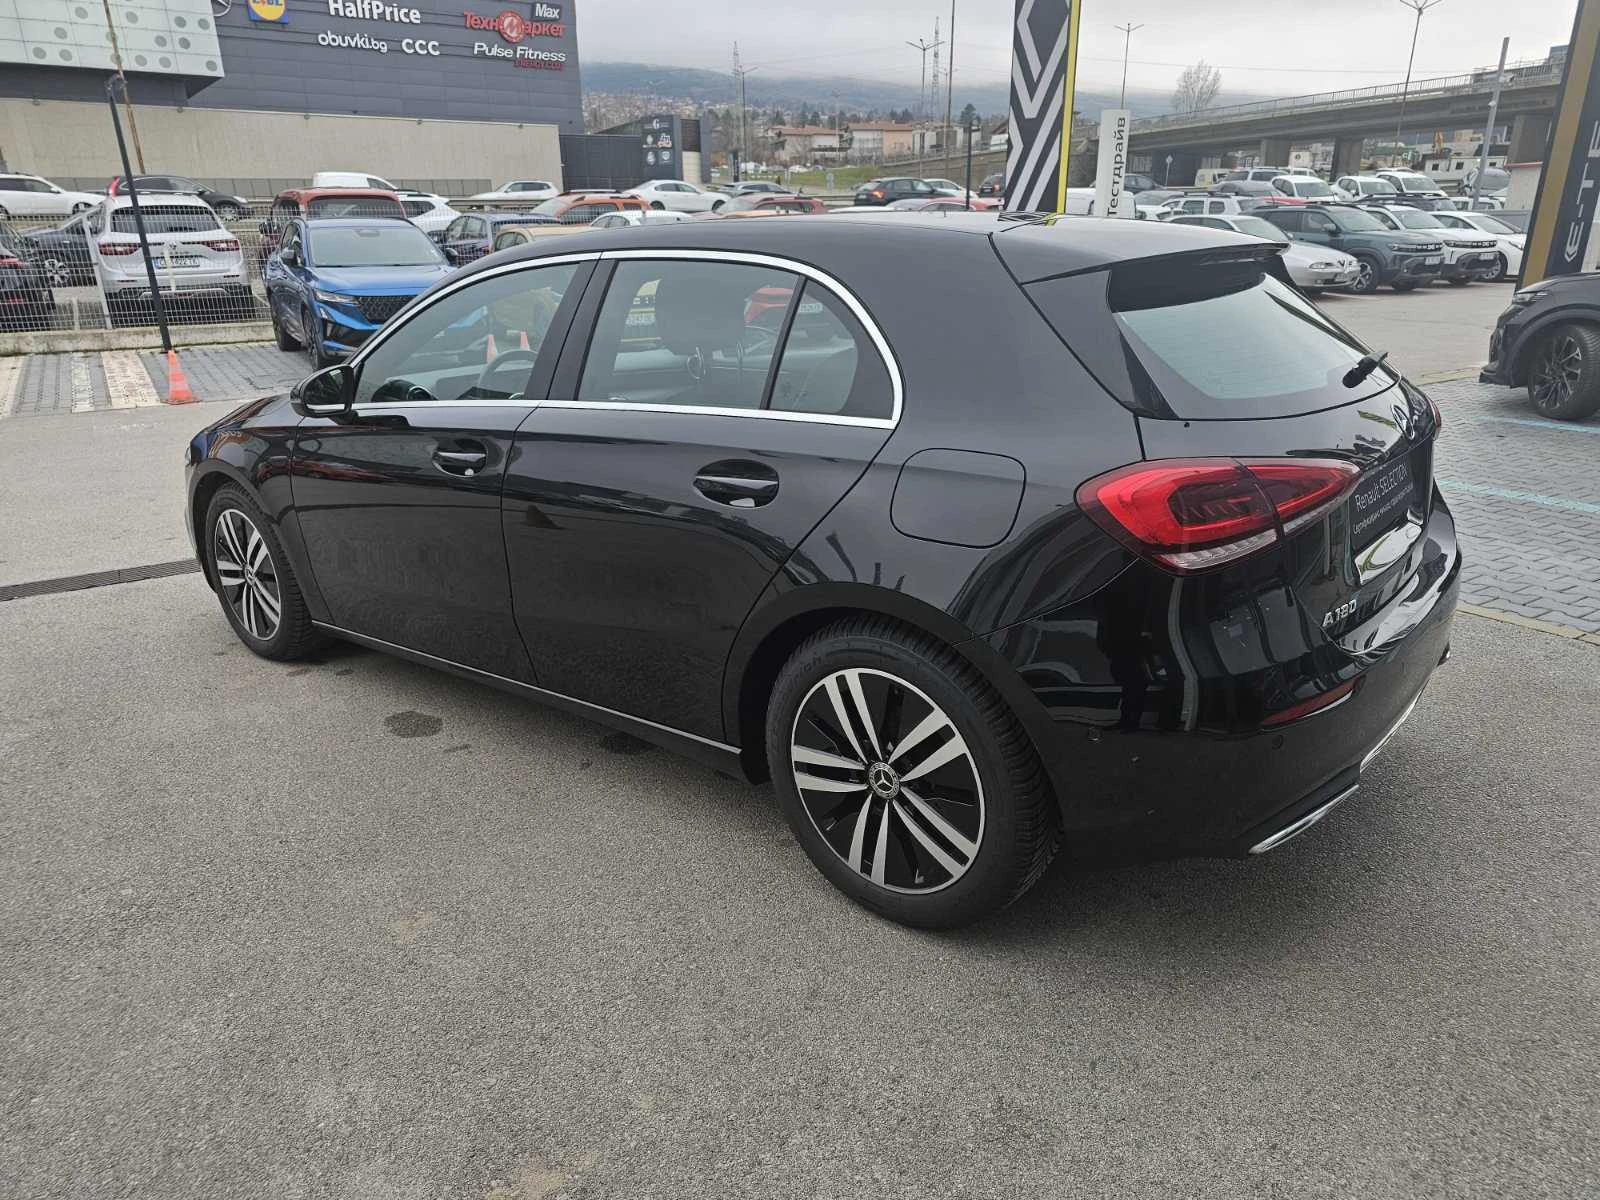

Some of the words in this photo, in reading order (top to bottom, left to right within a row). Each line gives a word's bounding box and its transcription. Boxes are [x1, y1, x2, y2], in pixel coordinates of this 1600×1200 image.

[328, 0, 422, 24] HalfPrice
[535, 3, 560, 19] Max
[317, 30, 388, 53] obuvki.bg
[401, 38, 441, 56] CCC
[473, 42, 514, 59] Pulse
[516, 46, 567, 62] Fitness
[1106, 117, 1126, 217] Тестдрайв
[1354, 482, 1380, 512] Renault
